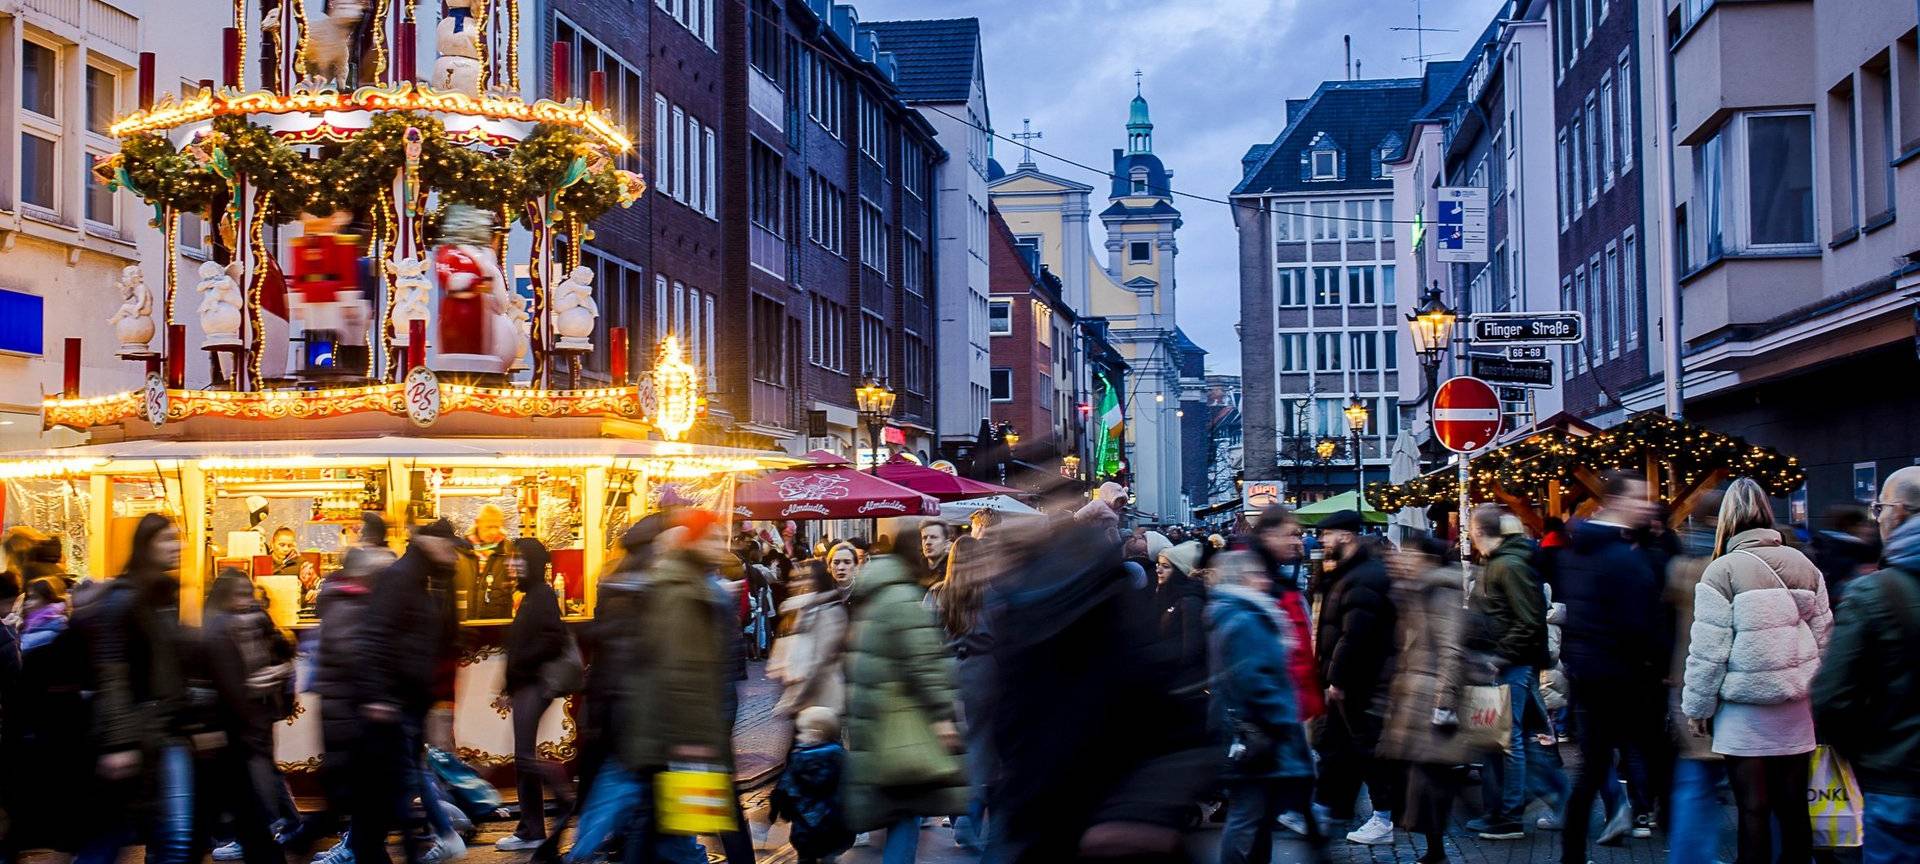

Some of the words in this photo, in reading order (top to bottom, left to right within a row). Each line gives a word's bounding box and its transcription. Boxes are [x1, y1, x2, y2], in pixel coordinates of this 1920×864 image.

[1484, 322, 1523, 338] Flinger
[1532, 320, 1570, 336] Straße
[781, 502, 830, 516] Almdudler
[858, 499, 907, 513] Almdudler
